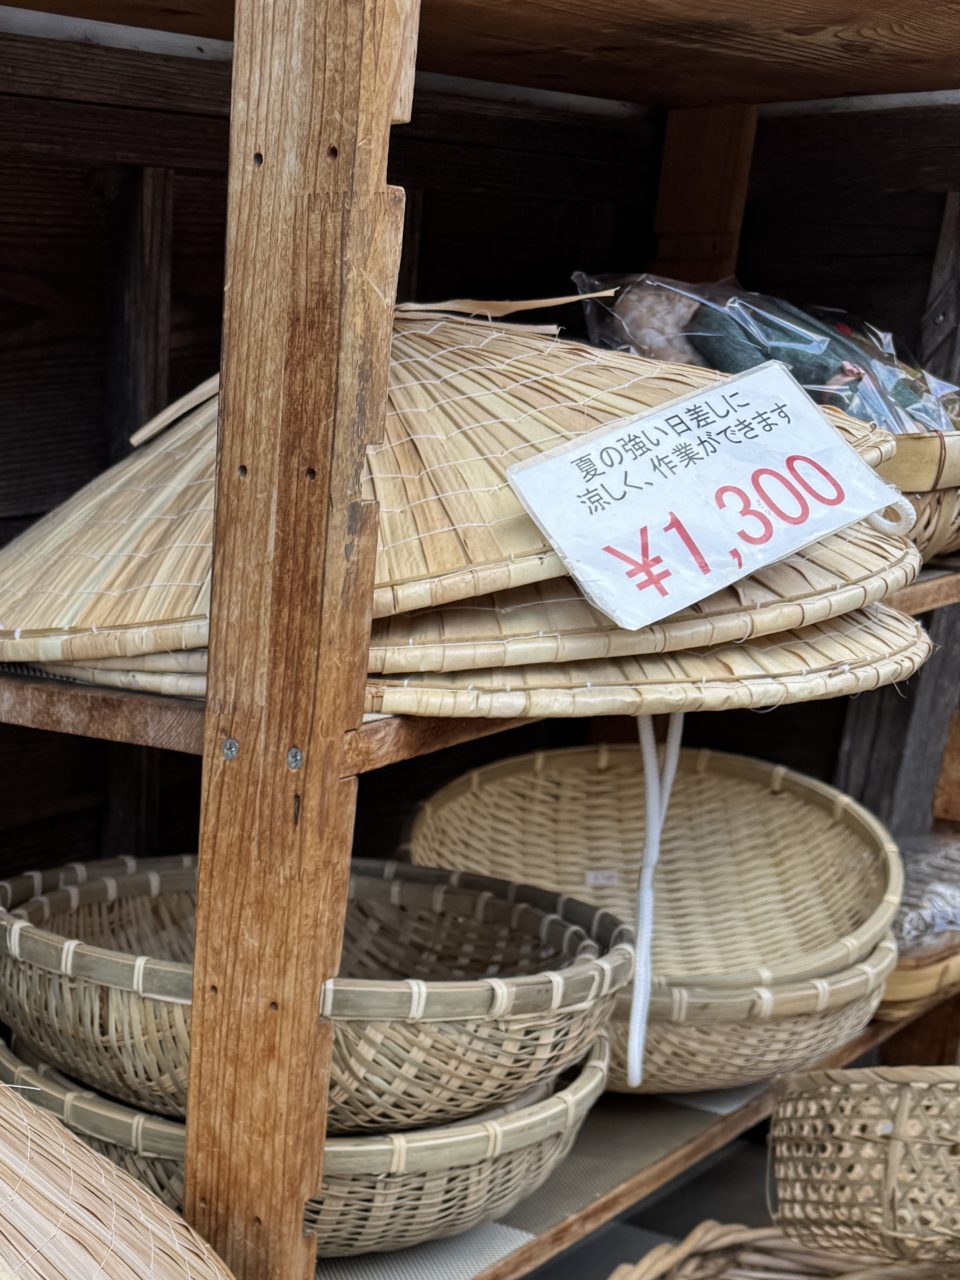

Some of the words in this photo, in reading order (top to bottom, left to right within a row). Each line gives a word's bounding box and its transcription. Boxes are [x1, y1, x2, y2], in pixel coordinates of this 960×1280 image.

[570, 389, 752, 483] 夏の強い日差しに
[575, 400, 793, 516] 涼しく、作業ができます
[602, 454, 846, 598] ¥1,300
